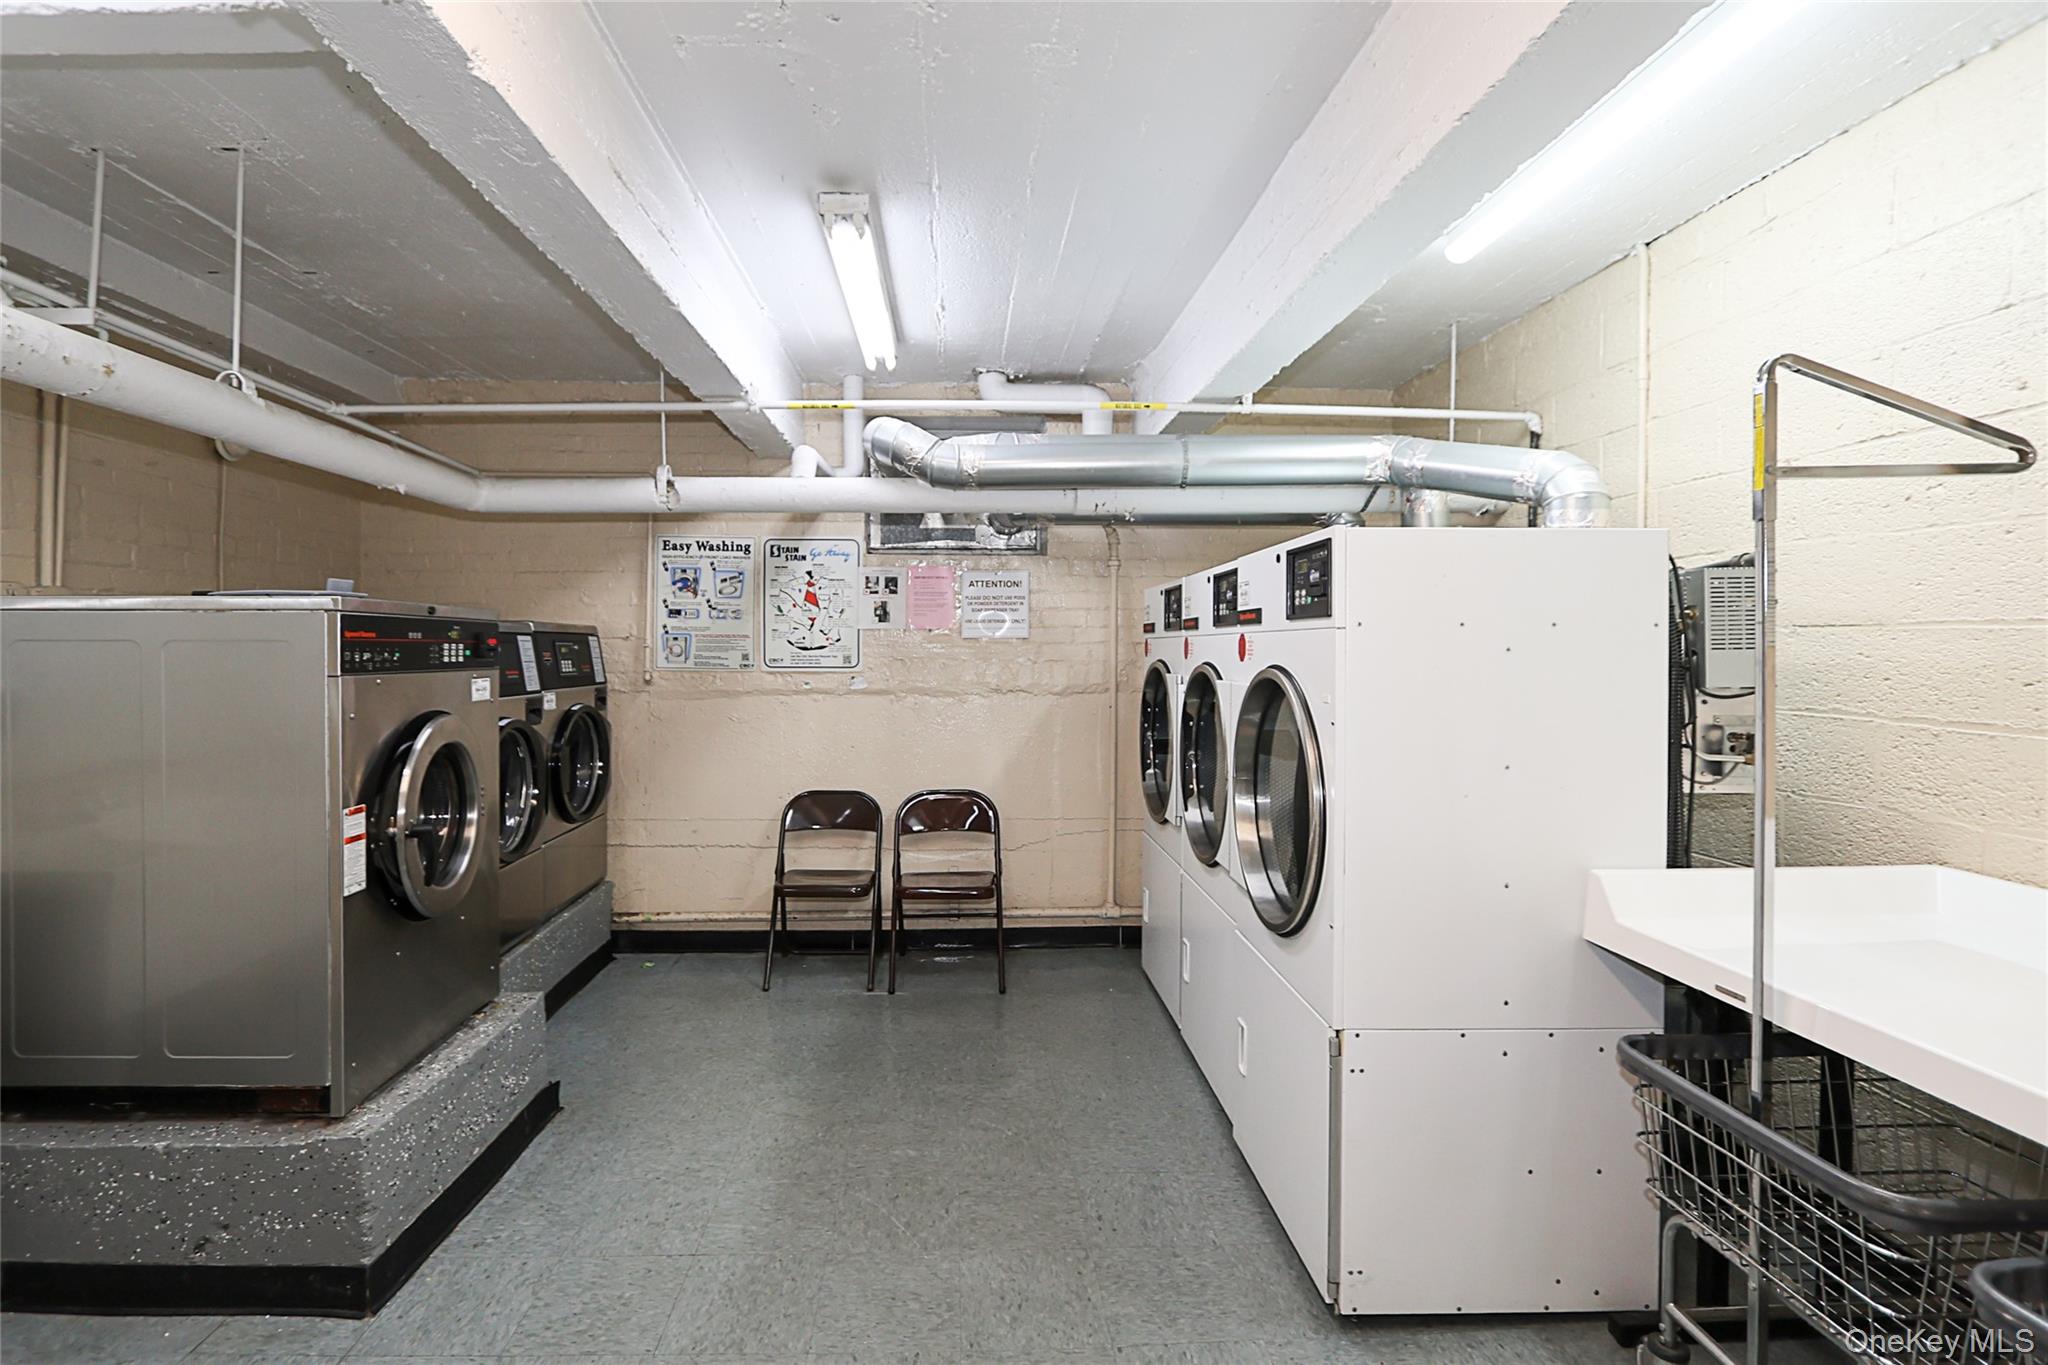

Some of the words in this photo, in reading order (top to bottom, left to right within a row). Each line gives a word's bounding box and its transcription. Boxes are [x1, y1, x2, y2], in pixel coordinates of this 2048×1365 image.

[662, 539, 692, 554] Easy
[696, 540, 751, 555] Washing
[785, 554, 807, 562] STAIN
[824, 548, 850, 562] Away
[968, 580, 1022, 588] ATTENTION!
